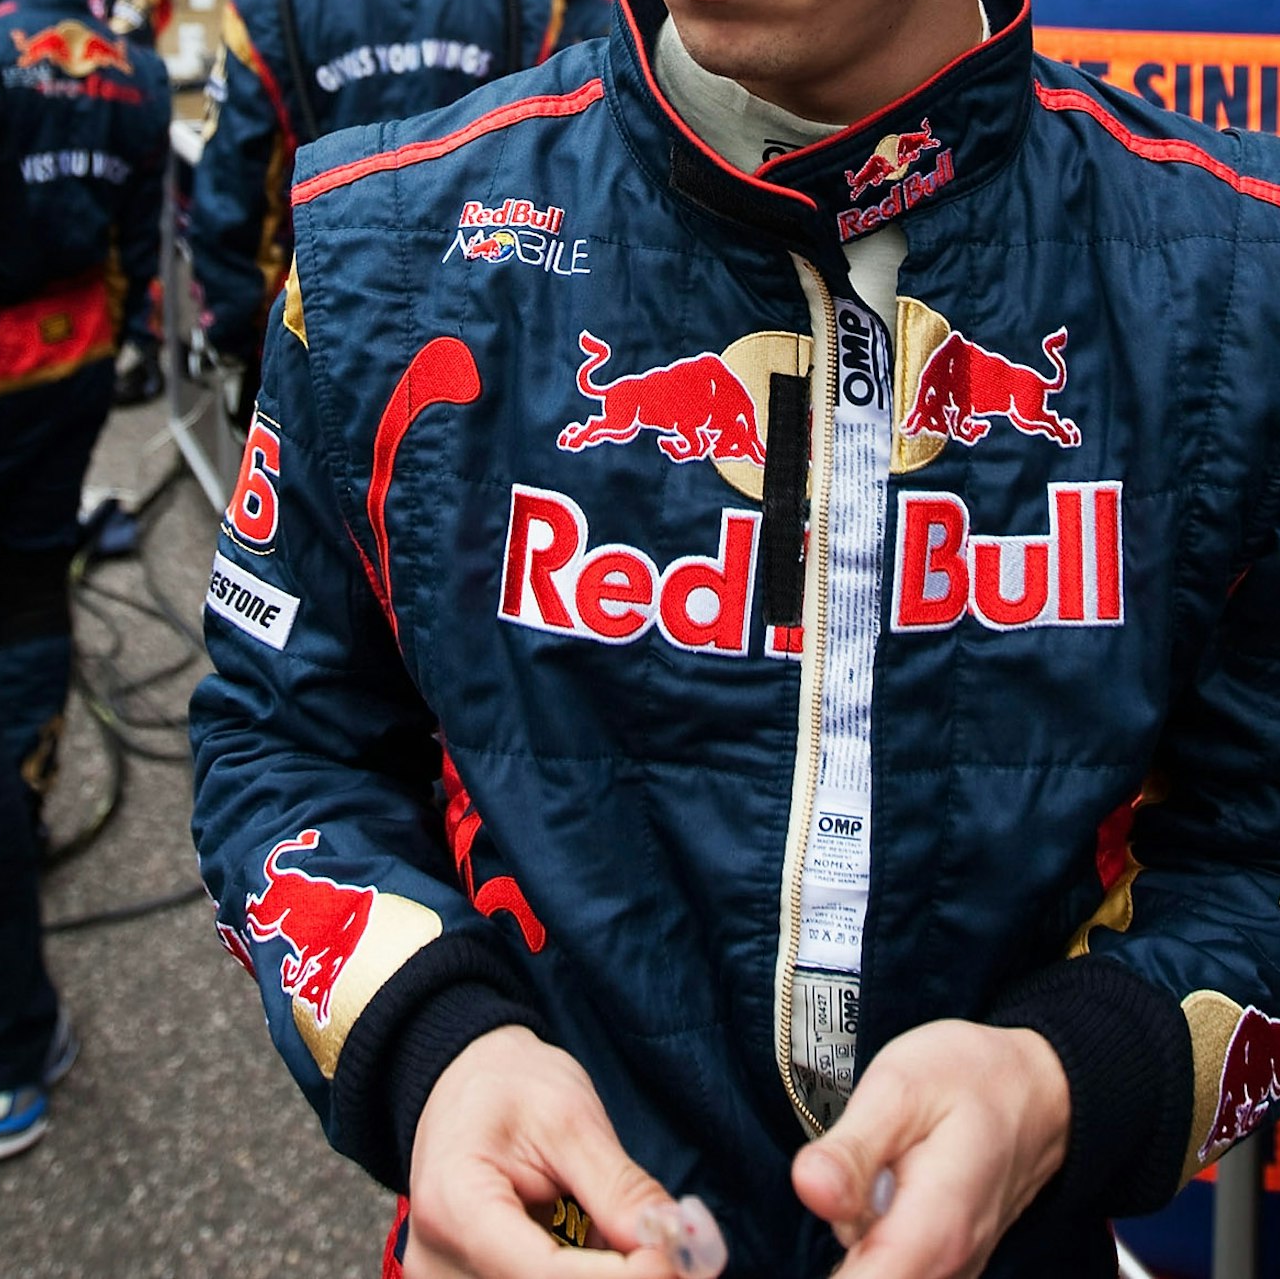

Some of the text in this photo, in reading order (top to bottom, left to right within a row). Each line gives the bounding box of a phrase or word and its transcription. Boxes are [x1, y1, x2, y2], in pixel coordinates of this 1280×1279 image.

[458, 197, 565, 236] Red Bull
[837, 148, 955, 242] Red Bull
[441, 228, 591, 276] MOBILE
[838, 309, 875, 407] OMP
[224, 412, 280, 543] 6
[208, 570, 281, 629] ESTONE
[497, 484, 762, 658] Red
[890, 479, 1125, 633] Bull
[818, 817, 863, 837] OMP
